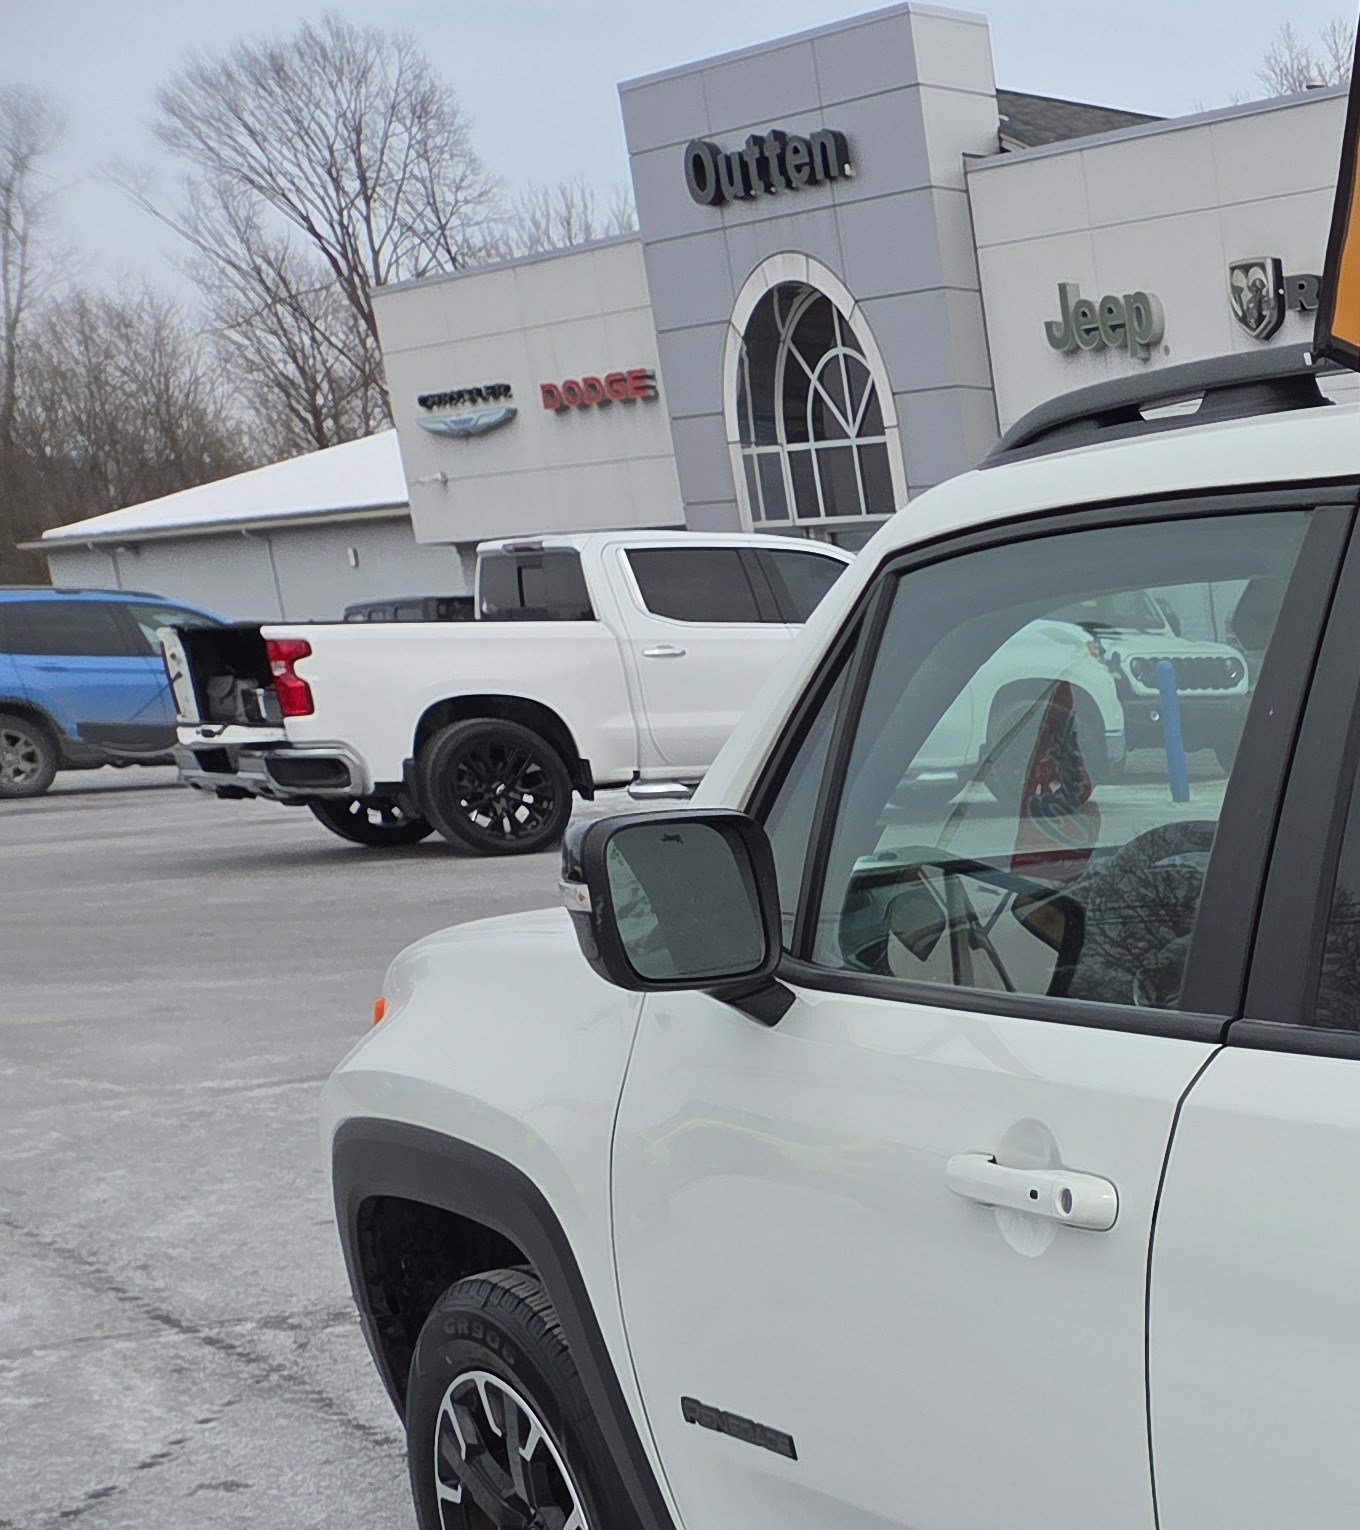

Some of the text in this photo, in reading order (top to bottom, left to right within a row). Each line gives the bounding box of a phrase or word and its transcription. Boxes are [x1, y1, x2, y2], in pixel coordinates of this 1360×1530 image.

[684, 128, 852, 206] Outten
[1043, 281, 1165, 360] Jeep
[539, 368, 658, 414] DODGE
